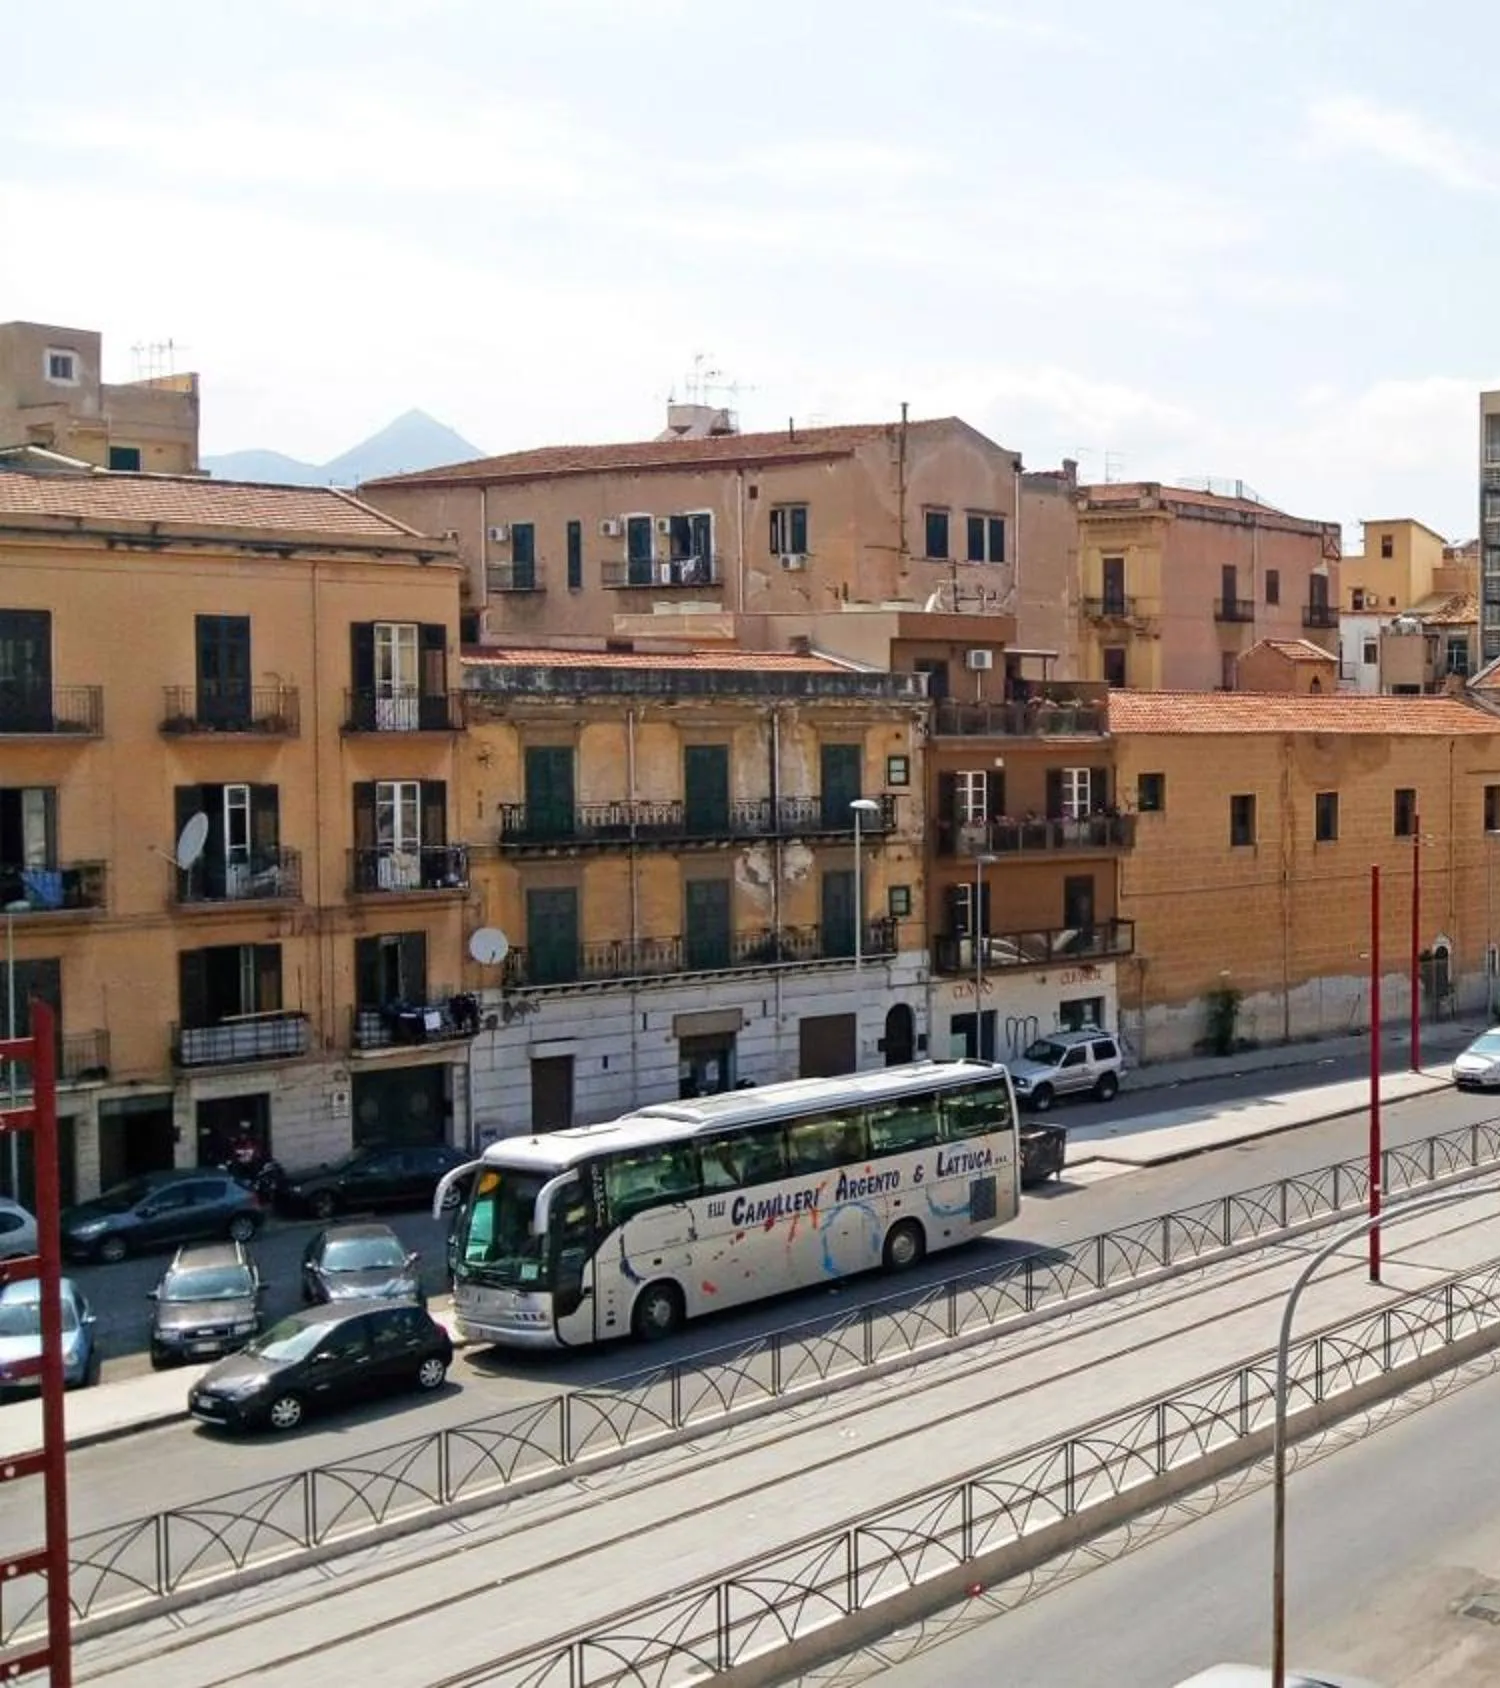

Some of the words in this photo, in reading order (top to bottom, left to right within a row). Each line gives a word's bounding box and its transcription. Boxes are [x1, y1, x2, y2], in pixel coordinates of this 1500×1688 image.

[835, 1169, 900, 1201] ARGENTO
[913, 1164, 924, 1183] &
[937, 1148, 993, 1177] LATTUCA
